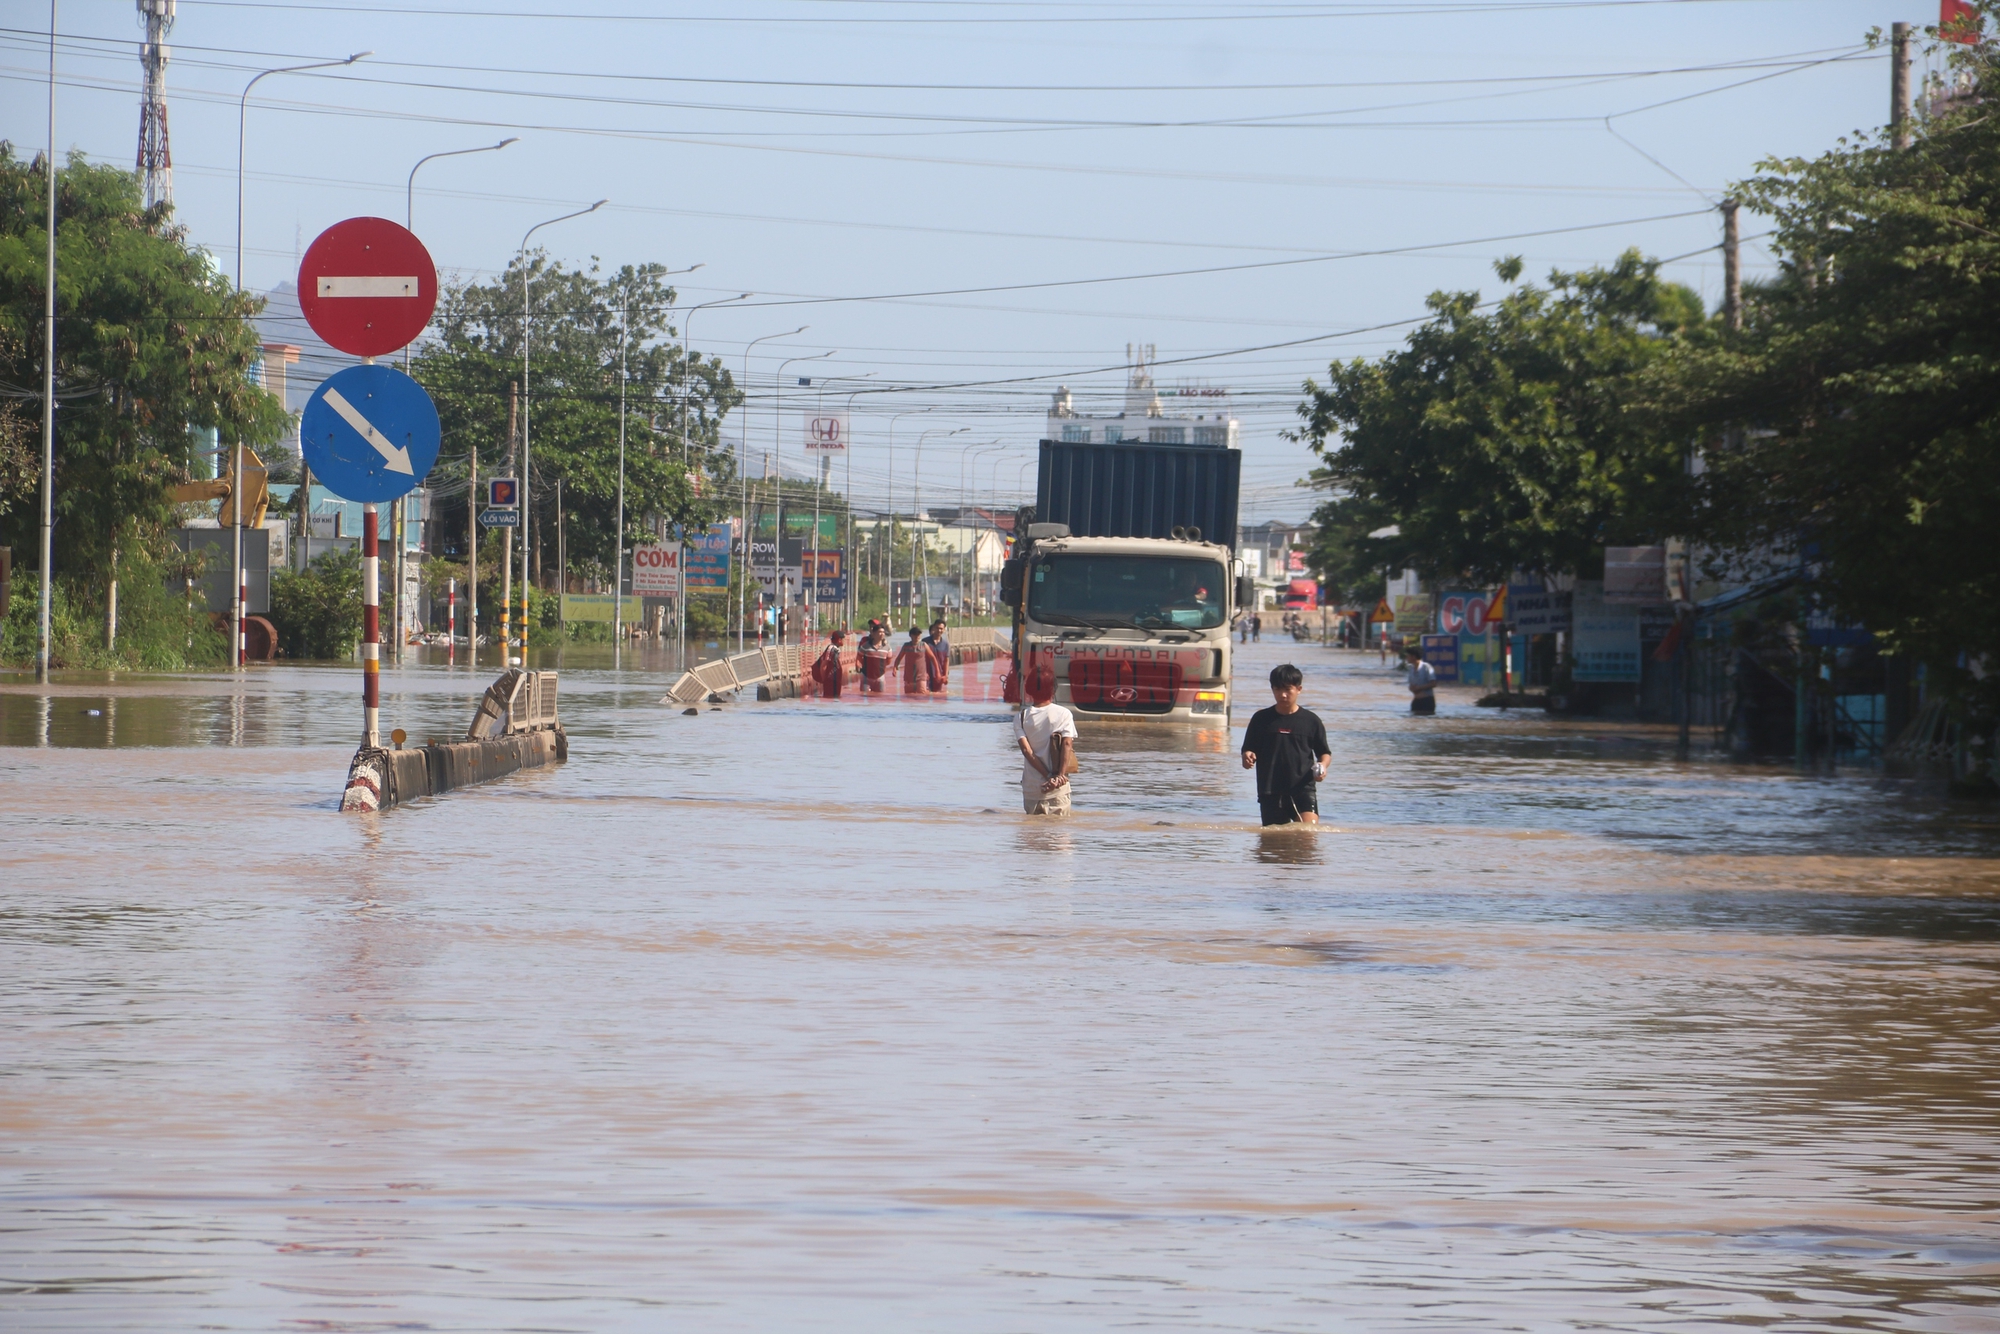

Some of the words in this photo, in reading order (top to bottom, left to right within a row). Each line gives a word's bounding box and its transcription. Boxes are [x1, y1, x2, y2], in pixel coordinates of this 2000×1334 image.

[484, 513, 497, 523] LỐI
[499, 513, 516, 523] VÀO
[734, 542, 776, 554] AROW
[636, 547, 678, 569] CƠM
[1074, 646, 1177, 661] HYUNDAI
